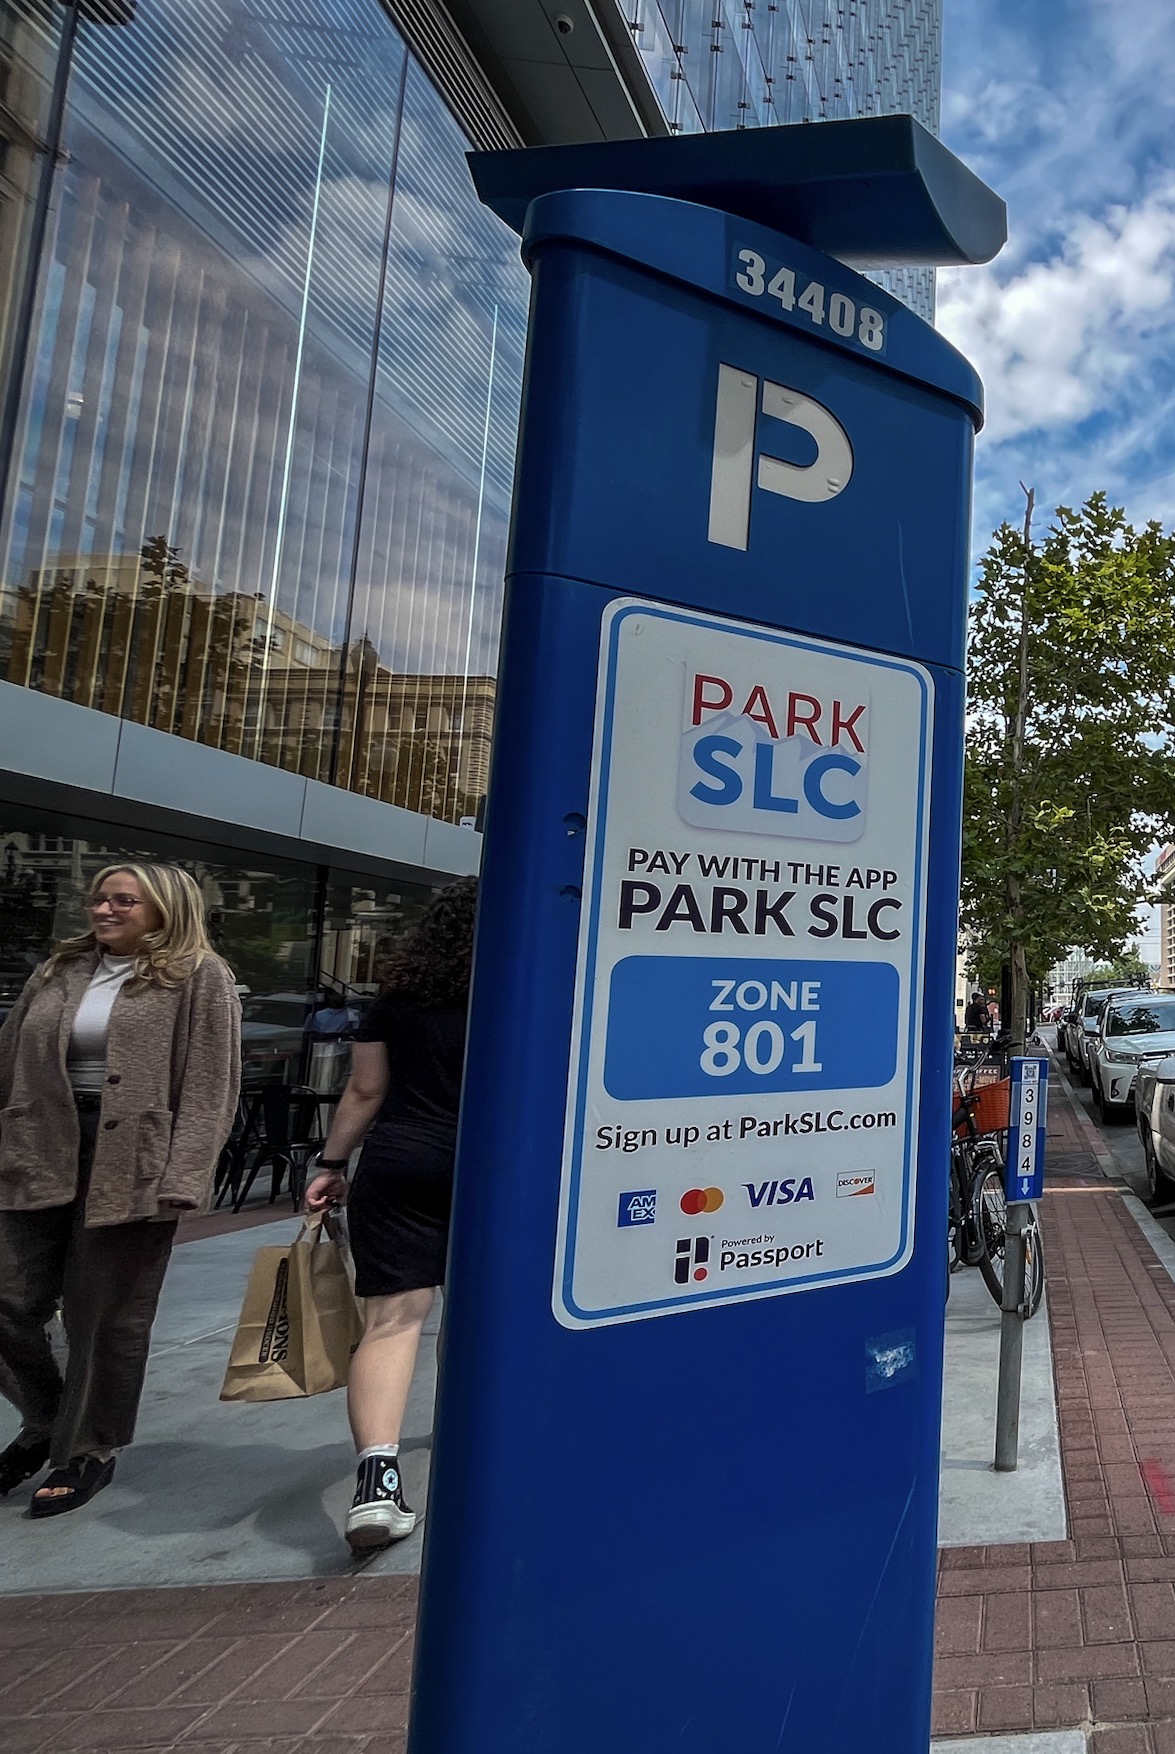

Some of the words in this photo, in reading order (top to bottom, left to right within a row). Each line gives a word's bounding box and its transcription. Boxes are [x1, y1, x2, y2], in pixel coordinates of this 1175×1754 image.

[736, 249, 884, 351] 34408
[708, 362, 854, 552] P
[692, 673, 866, 754] PARK
[689, 735, 862, 821] SLC
[627, 848, 692, 877] PAY
[698, 854, 781, 883] WITH
[787, 862, 841, 888] THE
[845, 868, 898, 892] APP
[618, 879, 797, 937] PARK
[807, 894, 903, 941] SLC
[708, 979, 822, 1013] ZONE
[699, 1020, 823, 1077] 801
[594, 1125, 658, 1153] Sign
[665, 1121, 699, 1148] up
[706, 1119, 733, 1142] at
[739, 1109, 897, 1140] ParkSLC.com
[740, 1177, 815, 1208] VISA
[838, 1176, 873, 1187] DISCOVER
[719, 1239, 824, 1271] Passport
[720, 1236, 762, 1249] Powered
[763, 1234, 775, 1245] by
